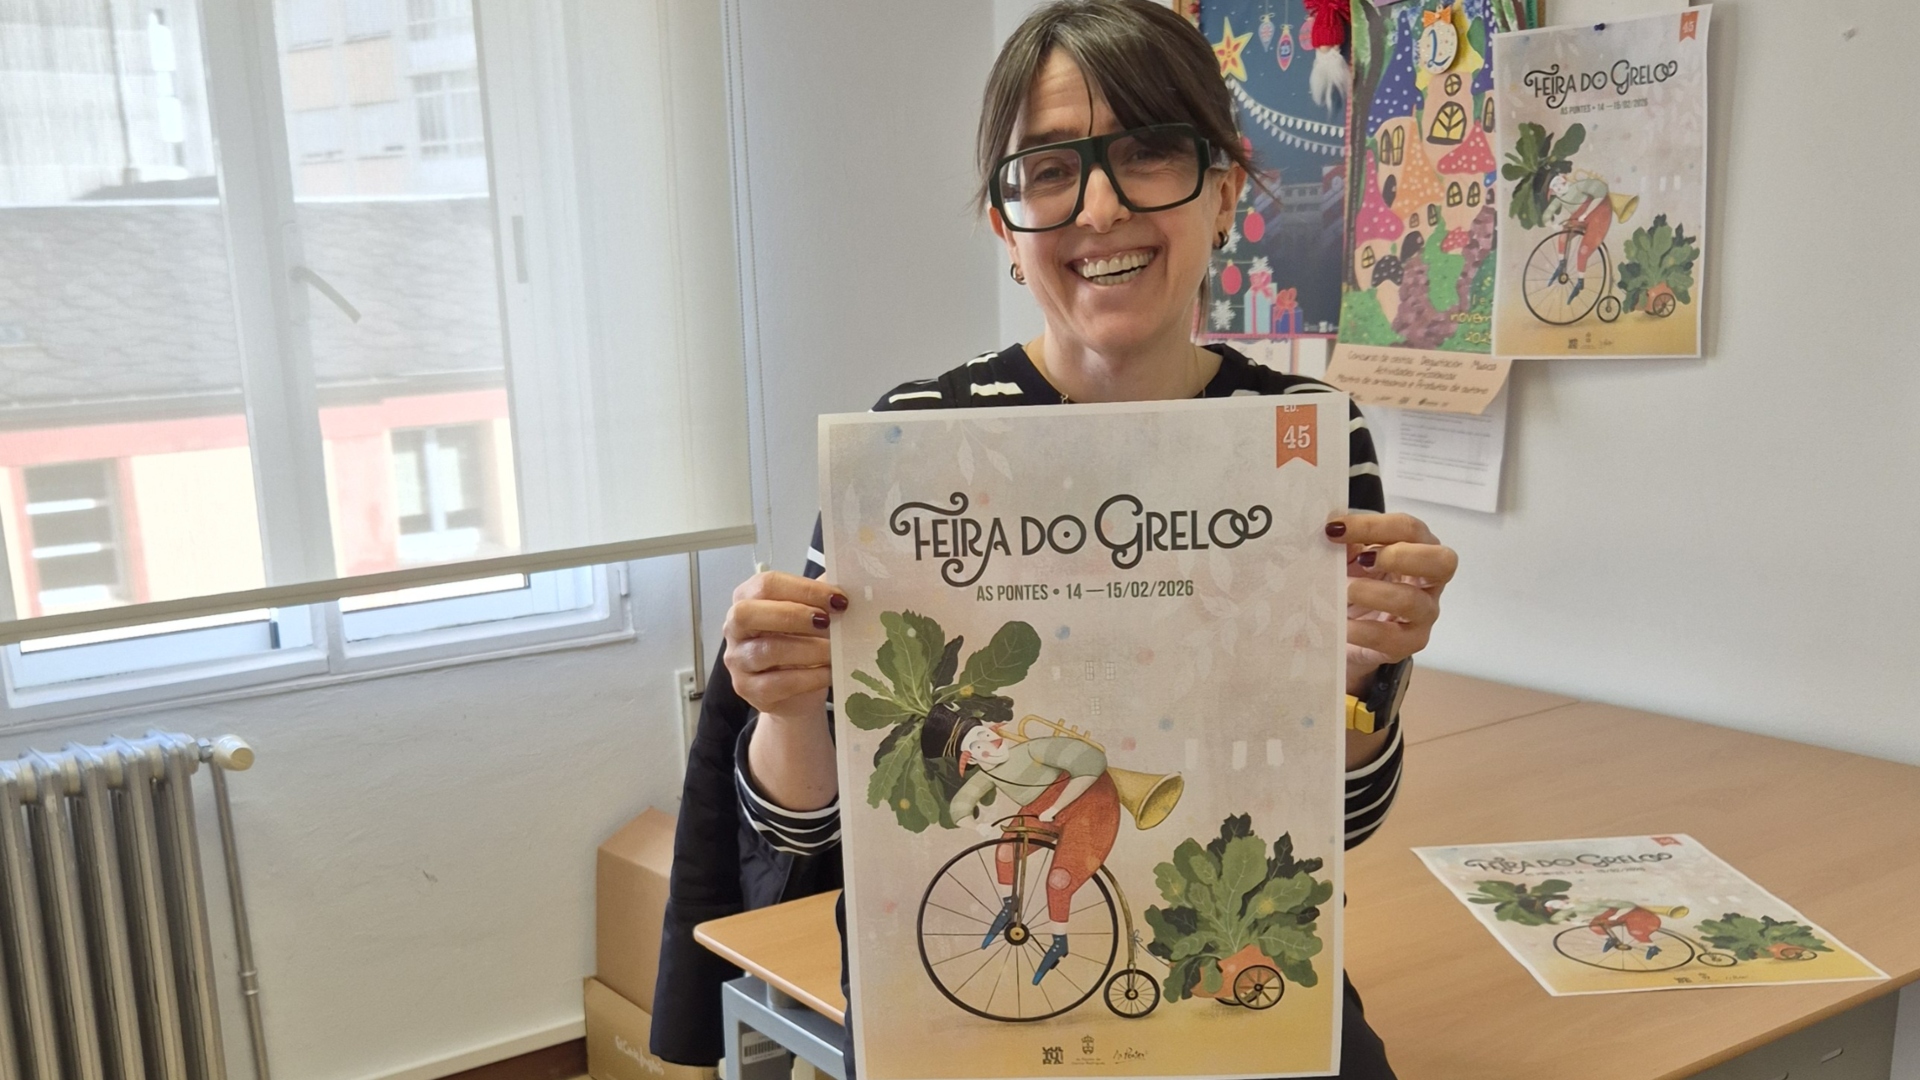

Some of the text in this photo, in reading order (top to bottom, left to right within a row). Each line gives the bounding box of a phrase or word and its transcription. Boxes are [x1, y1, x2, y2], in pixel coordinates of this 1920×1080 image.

[1523, 59, 1678, 109] FEIRA DO GRELO
[1283, 425, 1311, 449] 45
[889, 491, 1273, 588] FEIRA DO GRELO
[976, 585, 994, 601] AS
[997, 583, 1049, 601] PONTES
